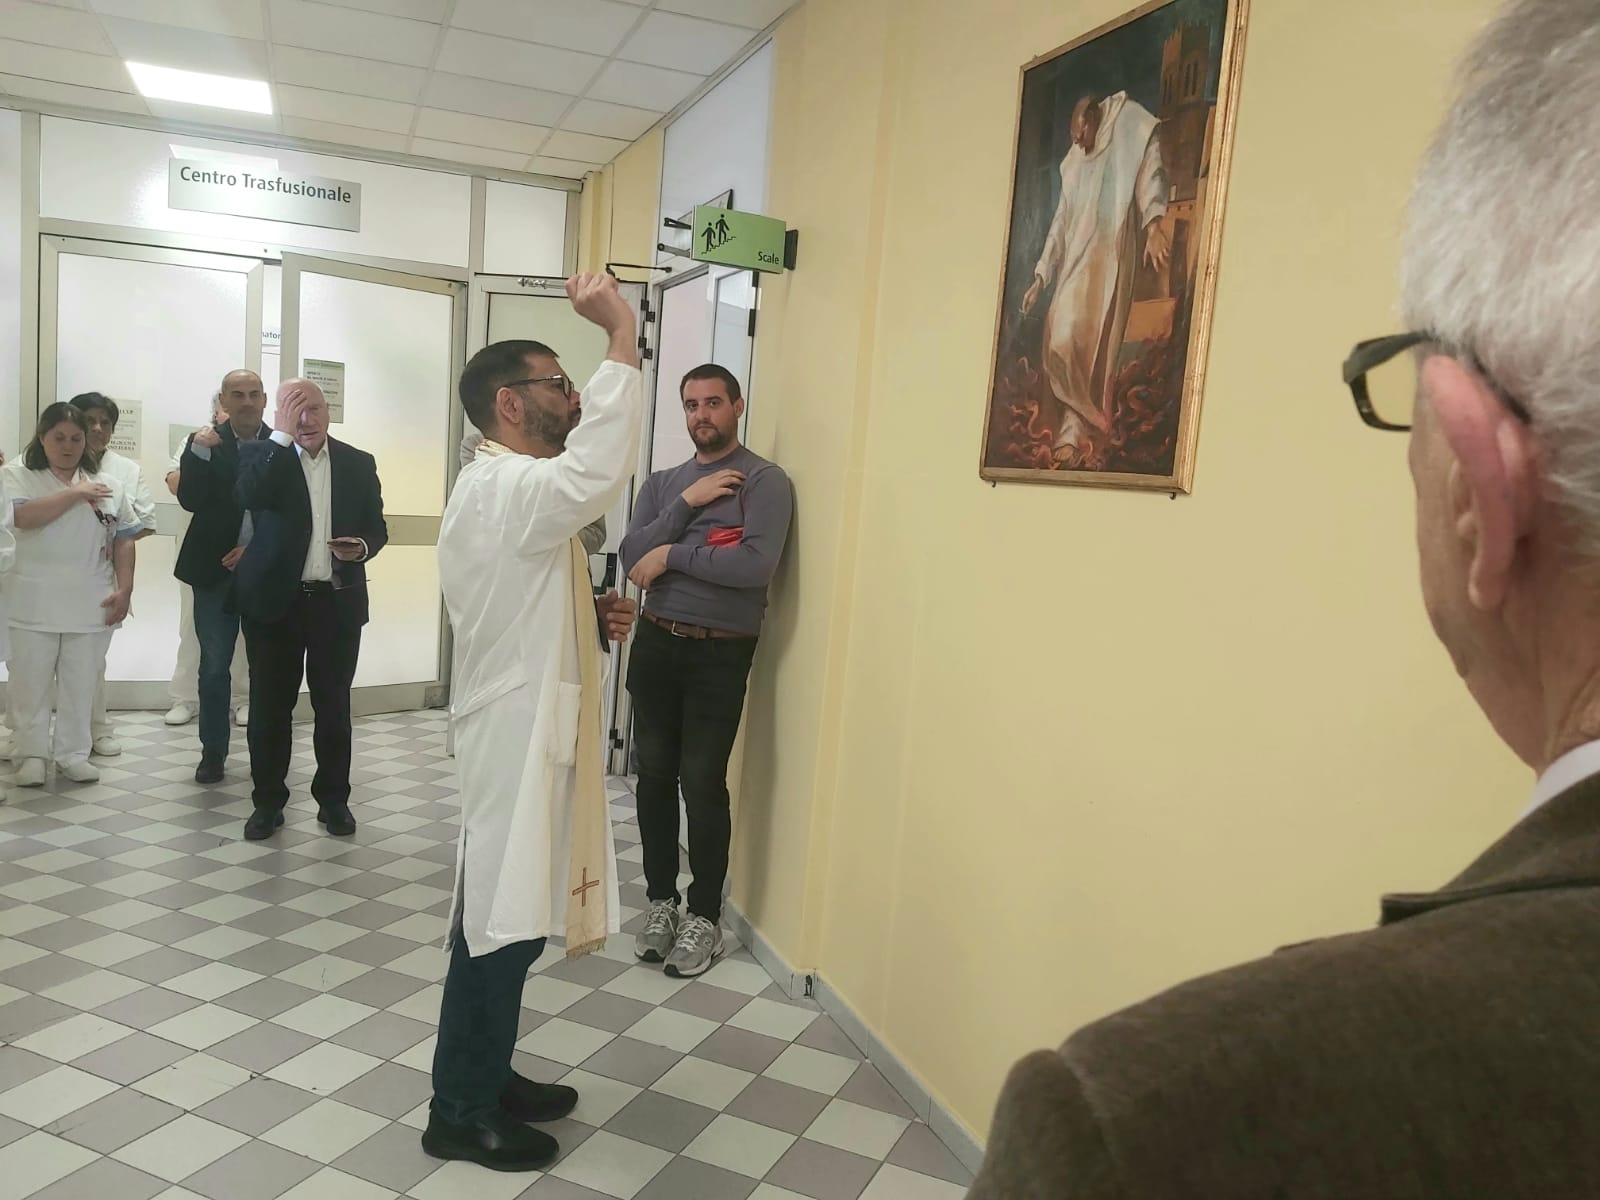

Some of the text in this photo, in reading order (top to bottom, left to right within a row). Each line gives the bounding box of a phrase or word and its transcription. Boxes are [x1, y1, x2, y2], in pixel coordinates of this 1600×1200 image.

[180, 166, 352, 203] Centro Trasfusionale
[757, 251, 780, 265] Scale
